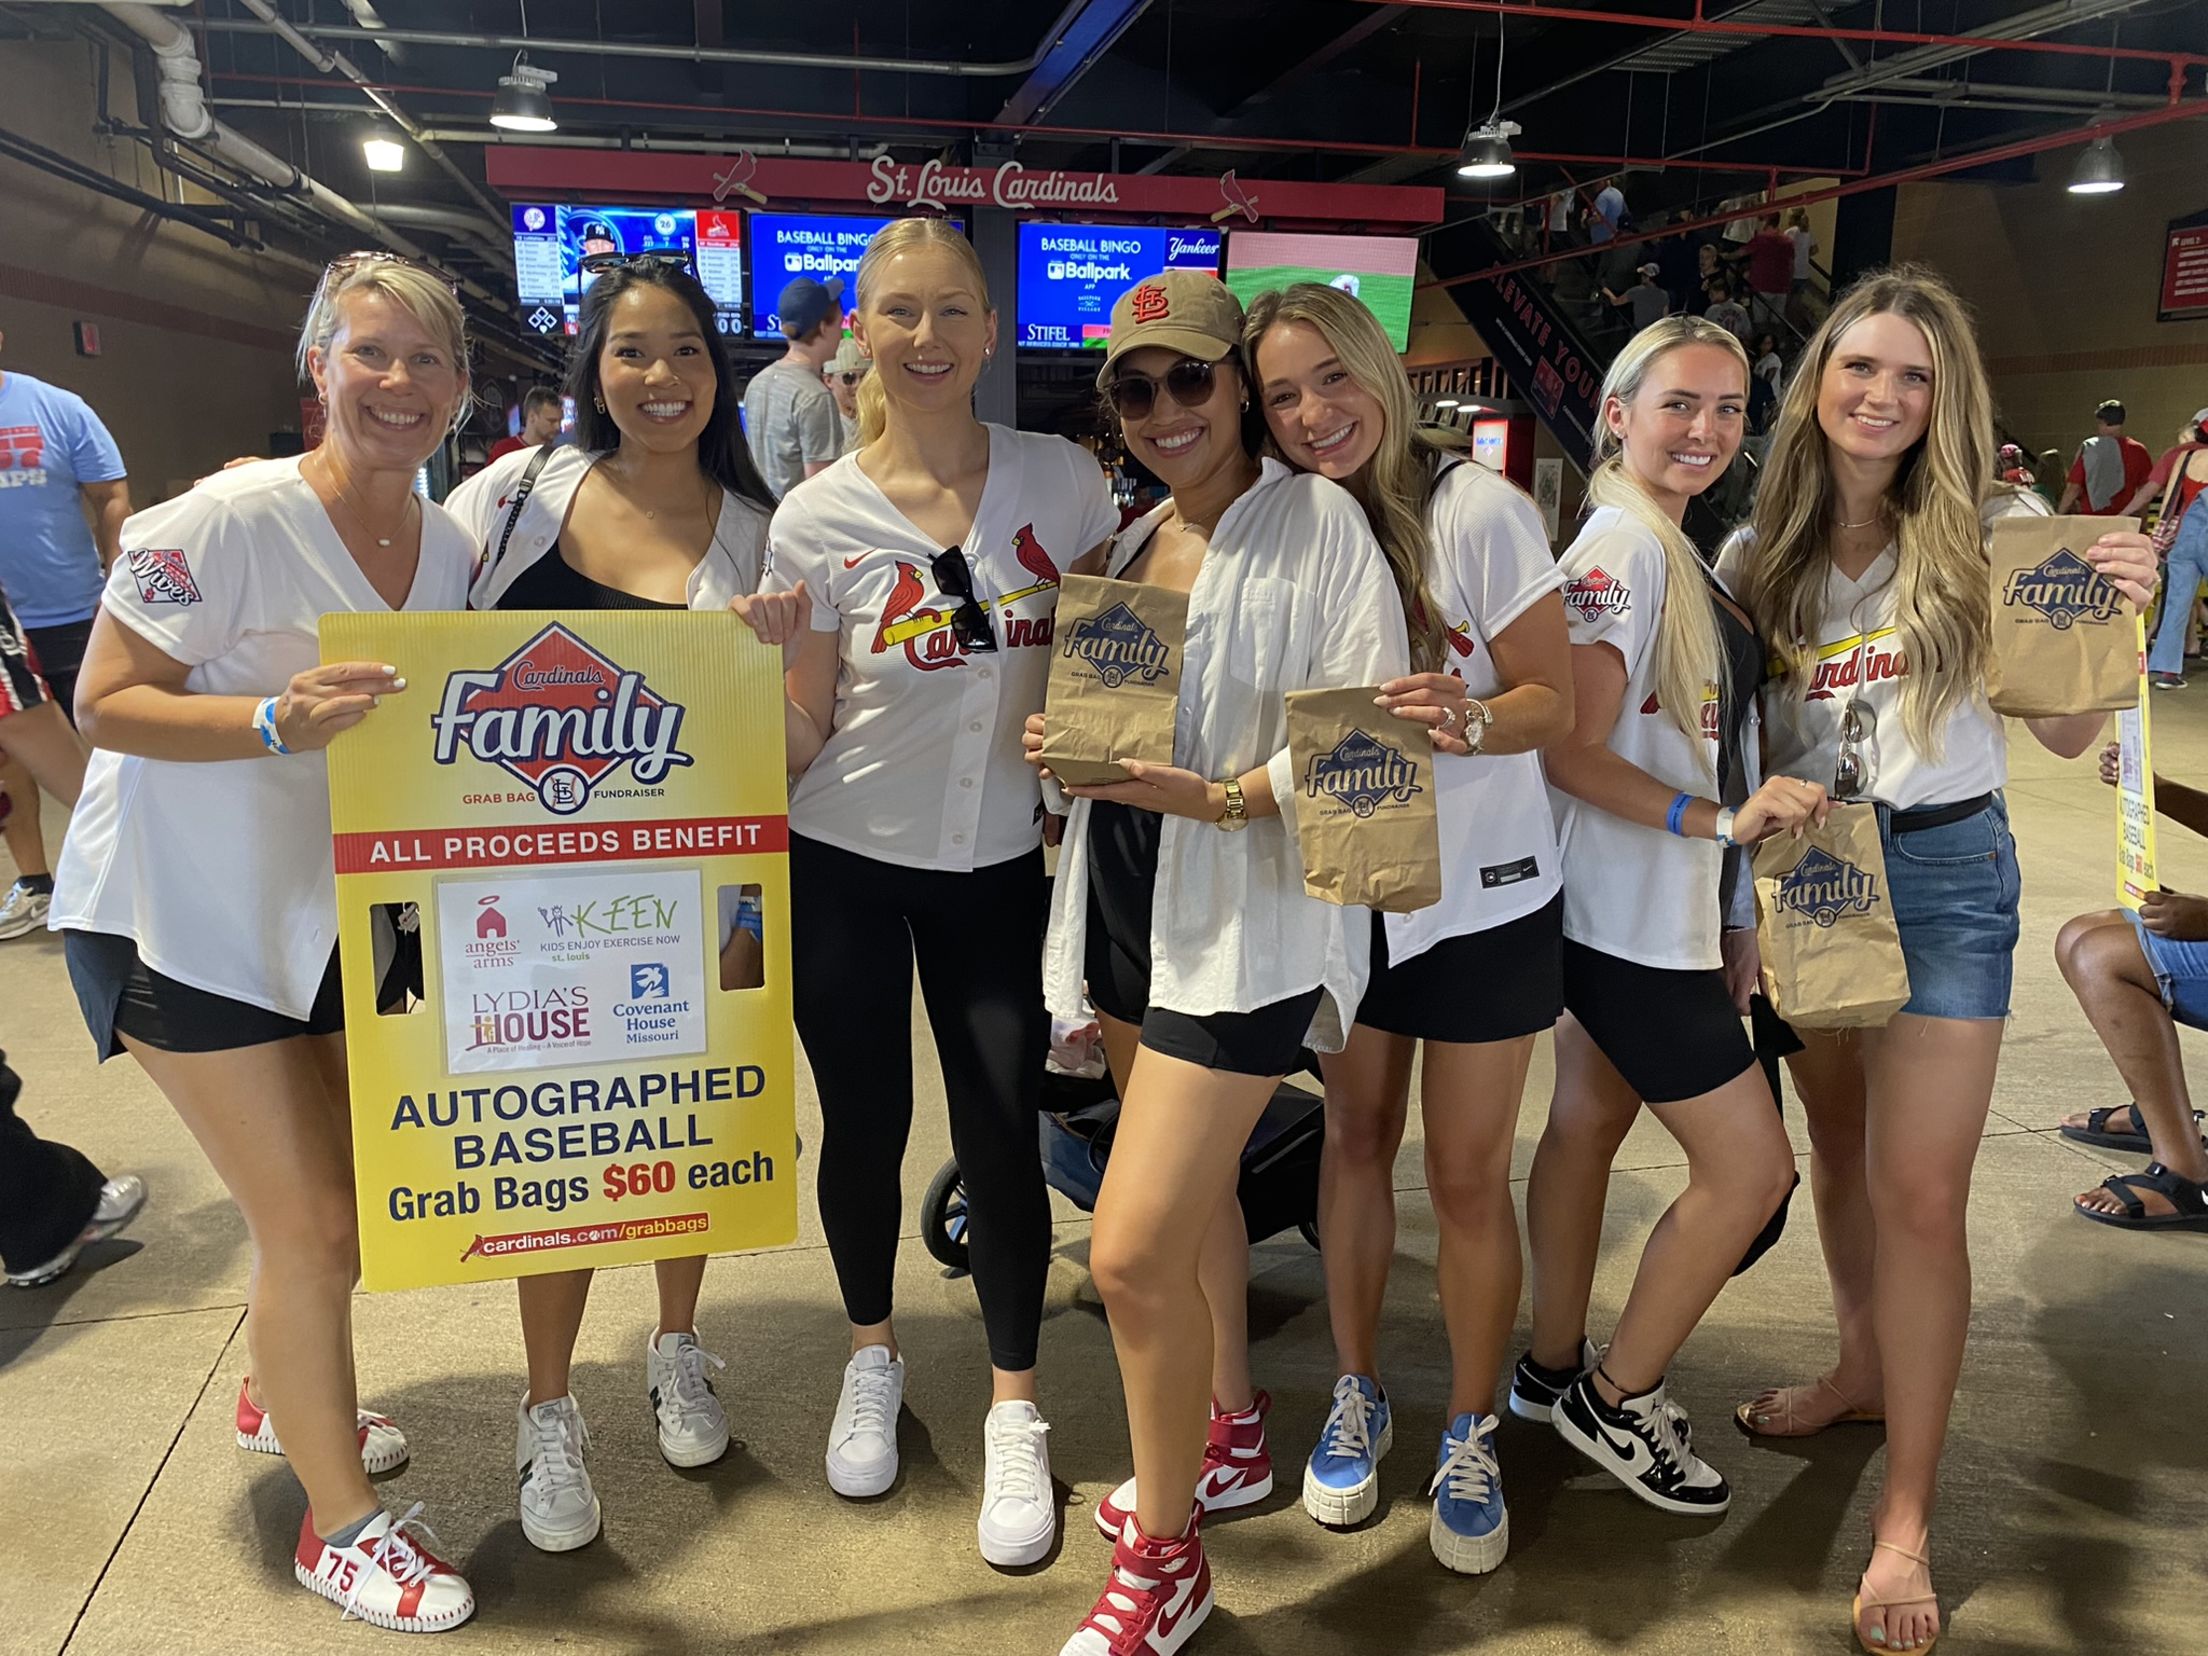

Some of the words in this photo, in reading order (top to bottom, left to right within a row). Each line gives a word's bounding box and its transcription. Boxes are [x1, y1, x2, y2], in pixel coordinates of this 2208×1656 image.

[867, 155, 912, 203] St.
[907, 159, 986, 211] Louis
[993, 161, 1119, 209] Cardinals
[777, 230, 835, 245] BASEBALL
[1041, 237, 1097, 252] BASEBALL
[1100, 239, 1142, 254] BINGO
[1168, 237, 1220, 261] Yankees
[1066, 261, 1131, 282] Ballpark
[1027, 323, 1071, 341] STIFEL
[130, 548, 194, 606] Wives
[2003, 568, 2123, 620] Family
[1563, 579, 1632, 615] Family
[1063, 617, 1170, 681] Family
[513, 661, 604, 692] Cardinals
[431, 671, 695, 784] Family
[1304, 747, 1423, 802] Family
[462, 793, 502, 805] GRAB
[506, 791, 536, 804] BAG
[594, 787, 665, 799] FUNDRAISER
[369, 838, 432, 864] ALL
[445, 829, 620, 860] PROCEEDS
[632, 823, 762, 852] BENEFIT
[1771, 862, 1880, 913] Family
[570, 894, 677, 938] KEEN
[540, 942, 565, 952] KIDS
[568, 940, 601, 951] ENJOY
[603, 936, 653, 949] EXERCISE
[655, 935, 681, 945] NOW
[566, 952, 590, 962] louis
[473, 956, 515, 969] arms
[473, 986, 589, 1014] LYDIA'S
[612, 1000, 690, 1017] Covenant
[472, 1007, 591, 1046] HOUSE
[626, 1015, 677, 1031] House
[626, 1030, 679, 1044] Missouri
[390, 1065, 766, 1131] AUTOGRAPHED
[454, 1114, 713, 1170] BASEBALL
[388, 1182, 480, 1221] Grab
[493, 1174, 590, 1211] Bags
[602, 1160, 677, 1202] $60
[687, 1151, 774, 1190] each
[482, 1215, 708, 1254] cardinals.com/grabbags
[327, 1550, 359, 1593] 75
